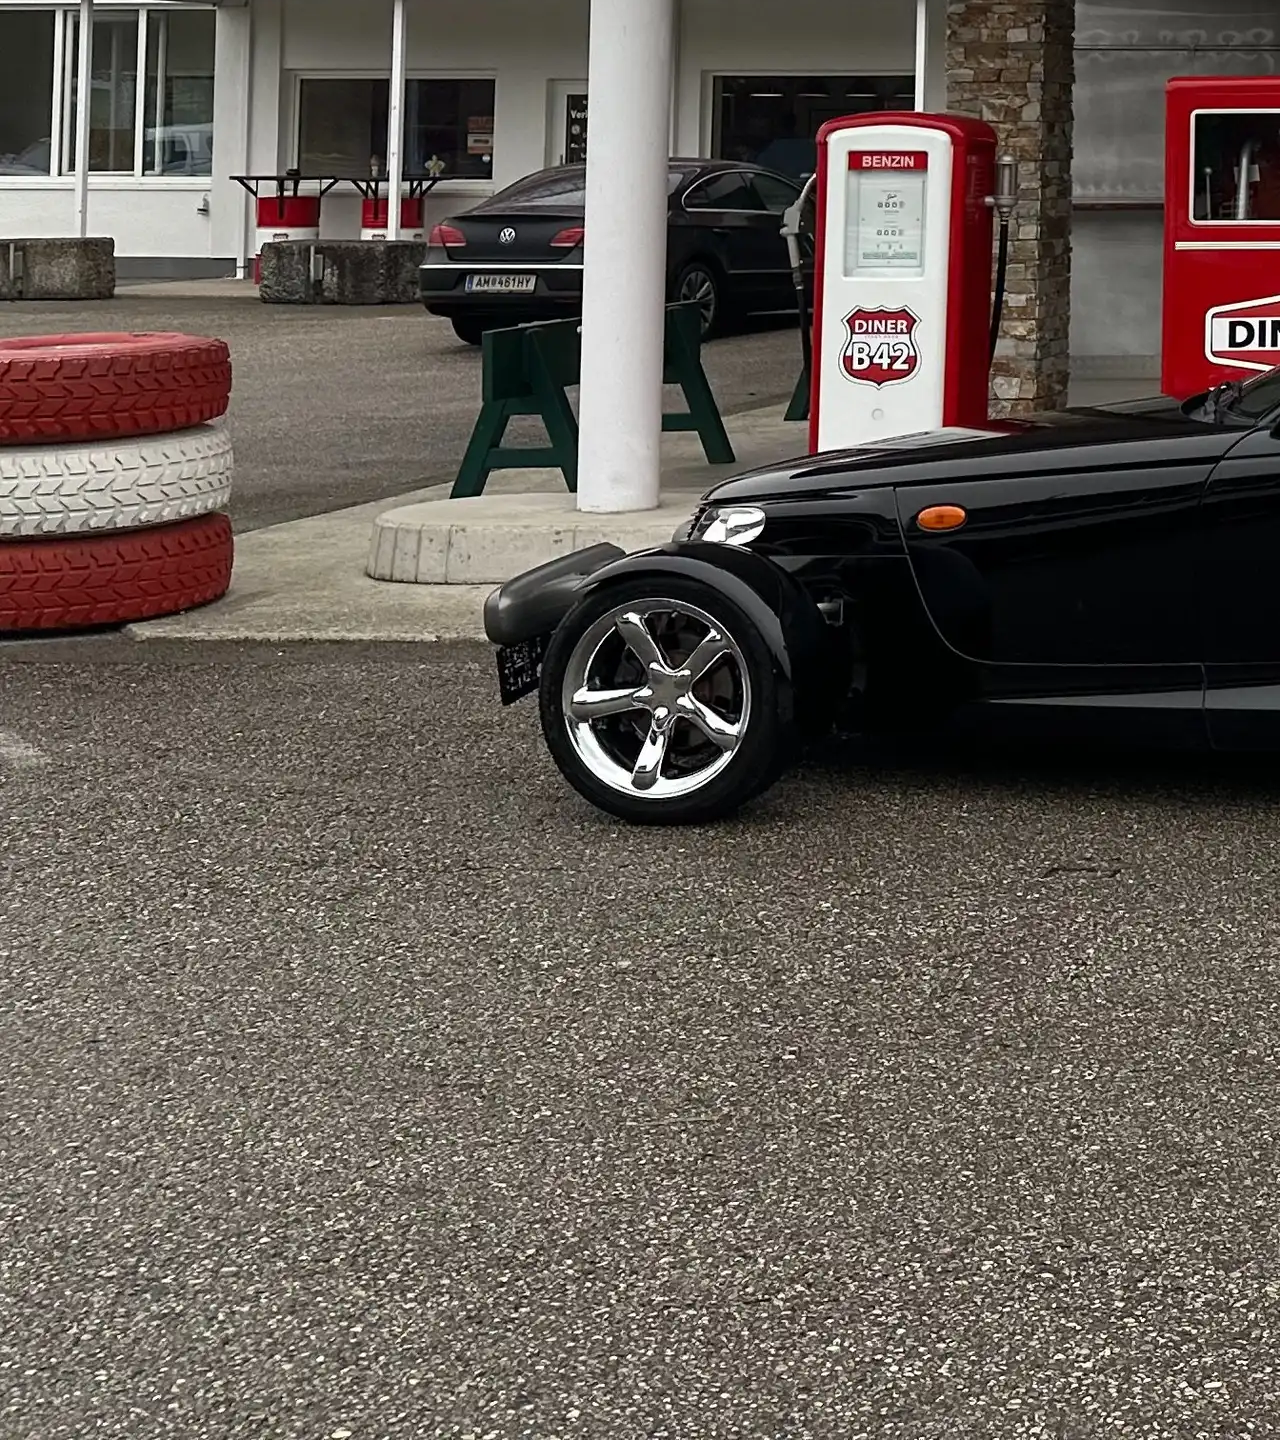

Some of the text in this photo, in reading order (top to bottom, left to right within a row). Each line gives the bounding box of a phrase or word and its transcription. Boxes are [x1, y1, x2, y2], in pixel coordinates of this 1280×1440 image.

[861, 155, 915, 168] BENZIN
[475, 276, 490, 288] AM
[854, 319, 908, 334] DINER
[852, 341, 910, 371] B42
